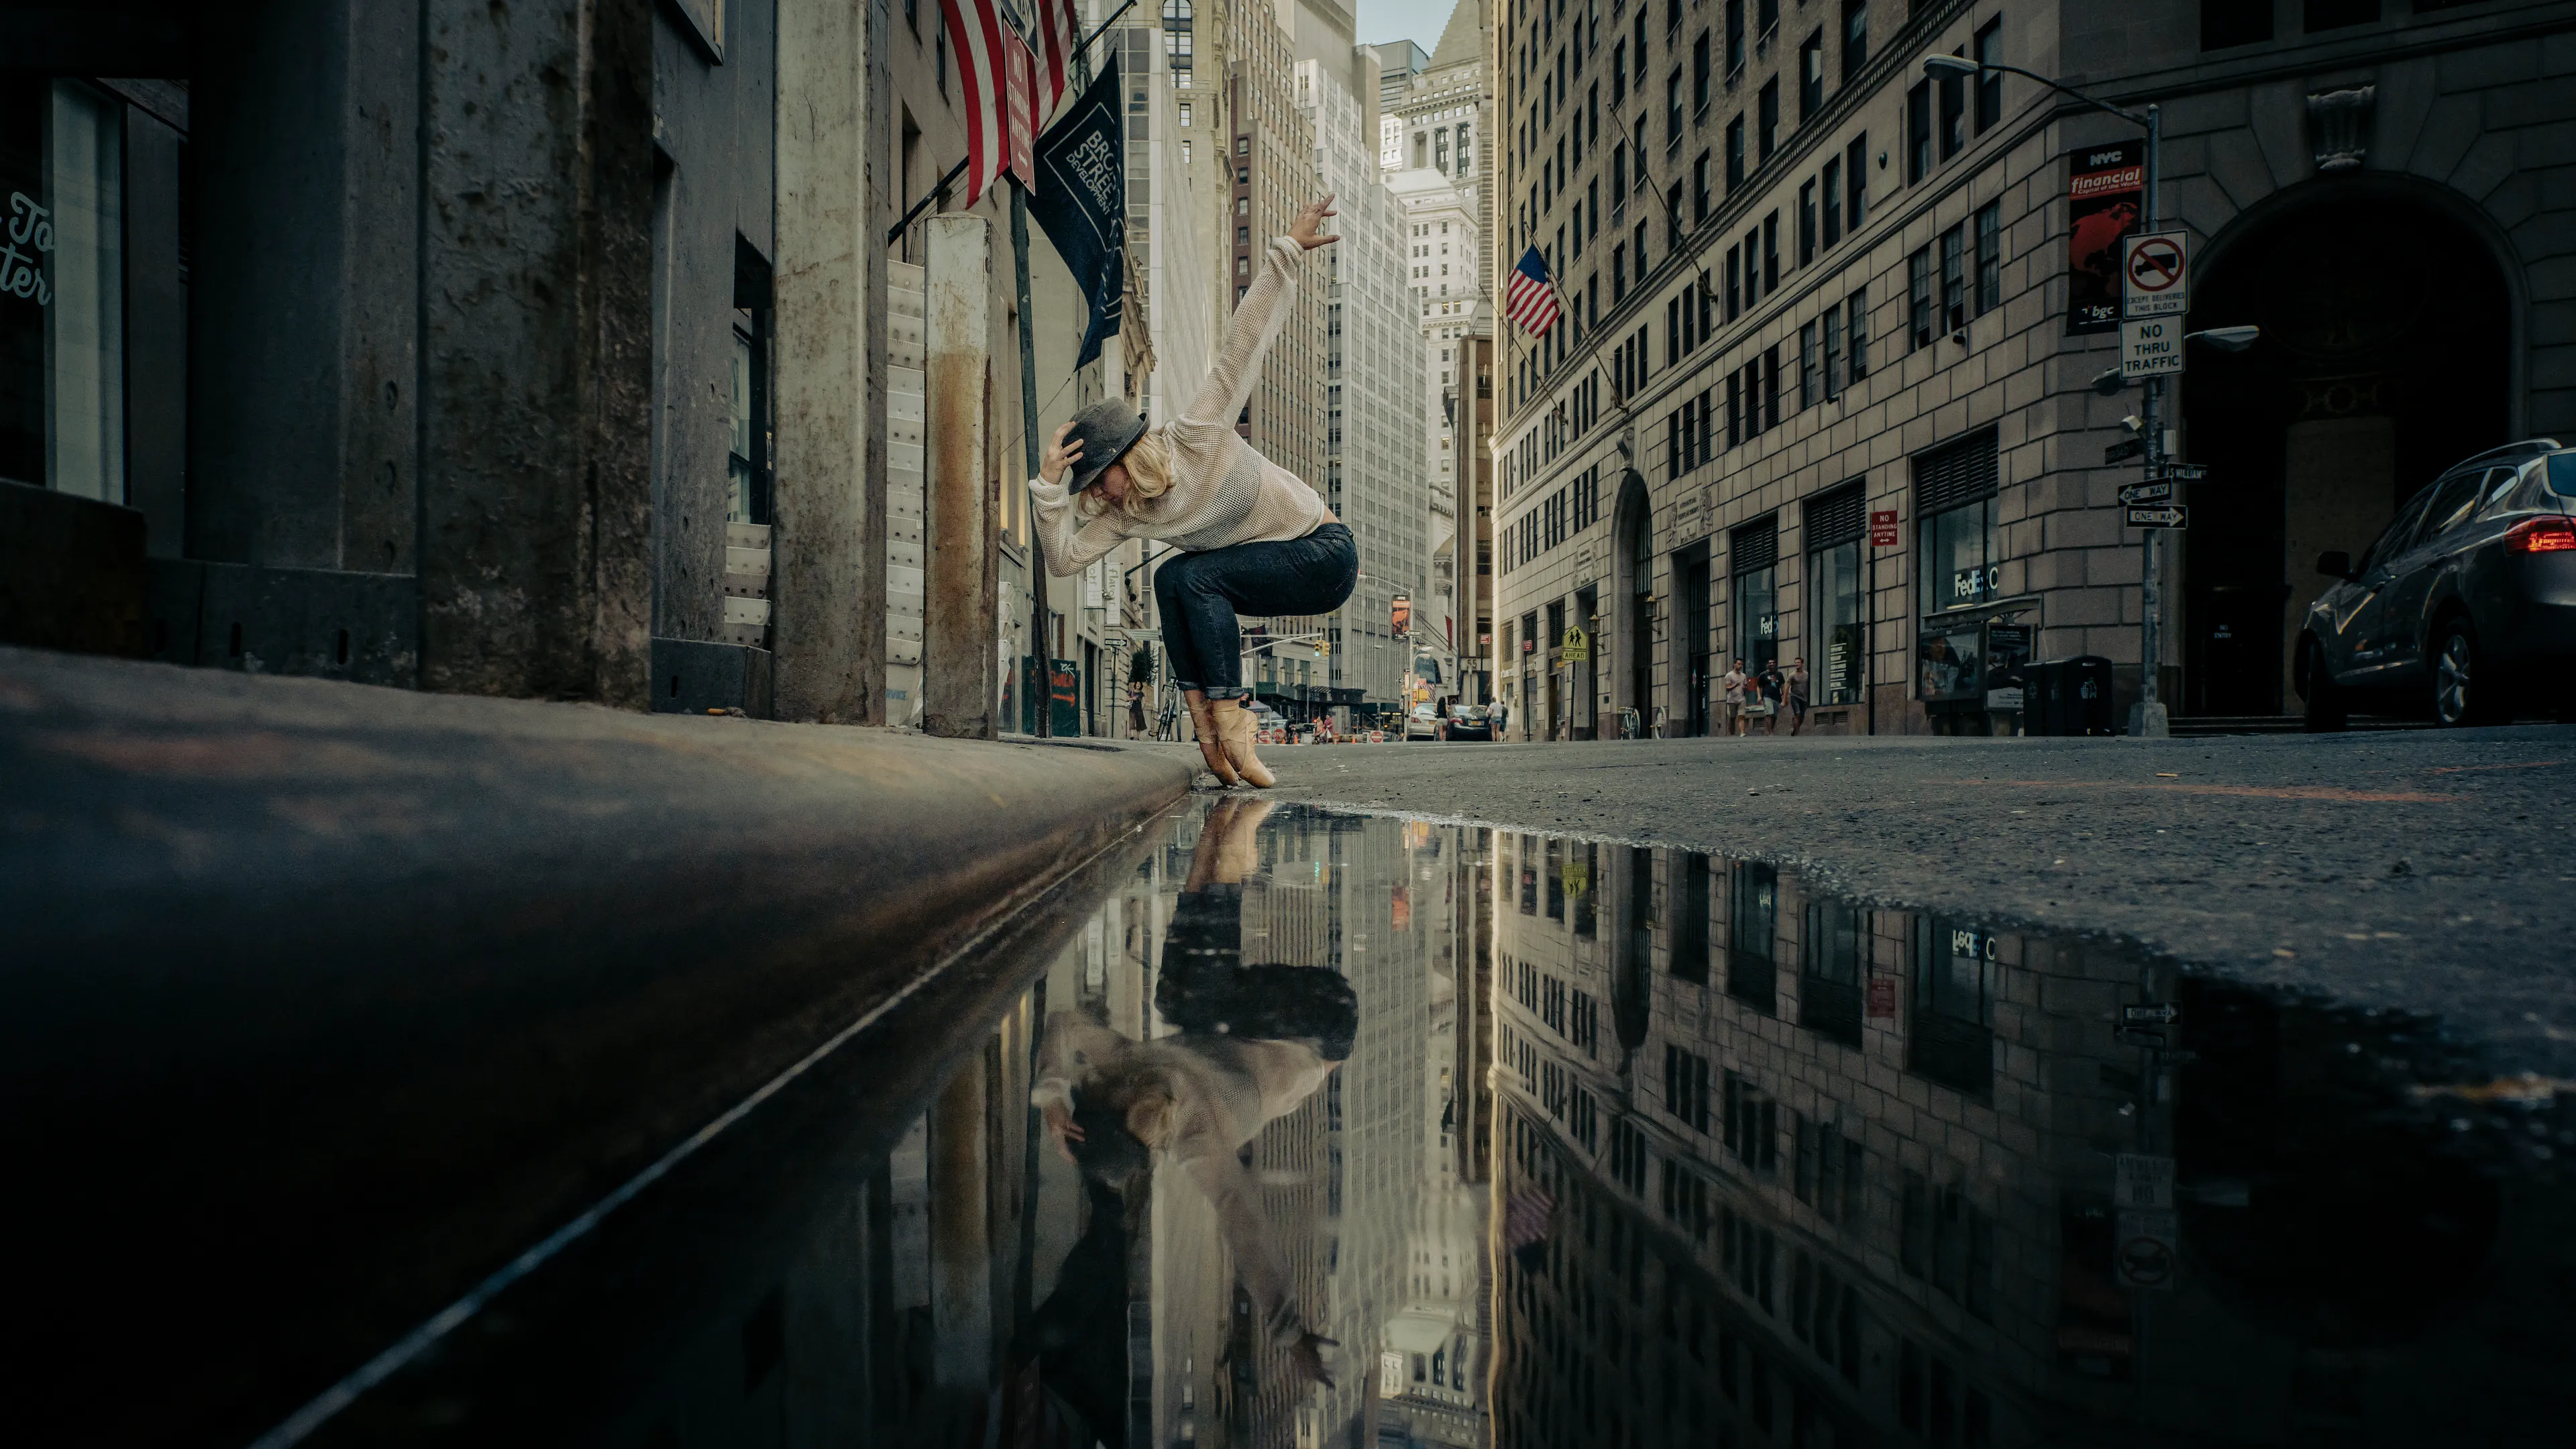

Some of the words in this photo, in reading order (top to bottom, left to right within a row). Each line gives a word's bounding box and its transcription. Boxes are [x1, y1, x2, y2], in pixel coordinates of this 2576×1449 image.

[1014, 48, 1022, 83] NO
[1008, 80, 1030, 125] STANDING
[1012, 113, 1030, 154] ANYTIME
[2090, 150, 2123, 167] NYC
[1074, 142, 1114, 206] STREE
[2072, 168, 2141, 194] financial
[1065, 153, 1110, 215] DEVELOPMENT
[2121, 179, 2141, 187] World
[8, 191, 55, 252] To
[0, 241, 52, 306] ter
[2127, 295, 2148, 304] EXCEPT
[2152, 292, 2185, 302] DELIVERIES
[2092, 305, 2114, 319] bgc
[2135, 304, 2150, 312] THIS
[2154, 302, 2178, 311] BLOCK
[2140, 324, 2163, 339] NO
[2134, 341, 2170, 356] THRU
[2125, 355, 2180, 372] TRAFFIC
[2176, 468, 2202, 479] WILLIAM
[2125, 489, 2141, 500] ONE
[2149, 485, 2167, 496] WAY
[2135, 512, 2152, 521] ONE
[2160, 513, 2177, 521] WAY
[1954, 570, 1988, 597] FedEx
